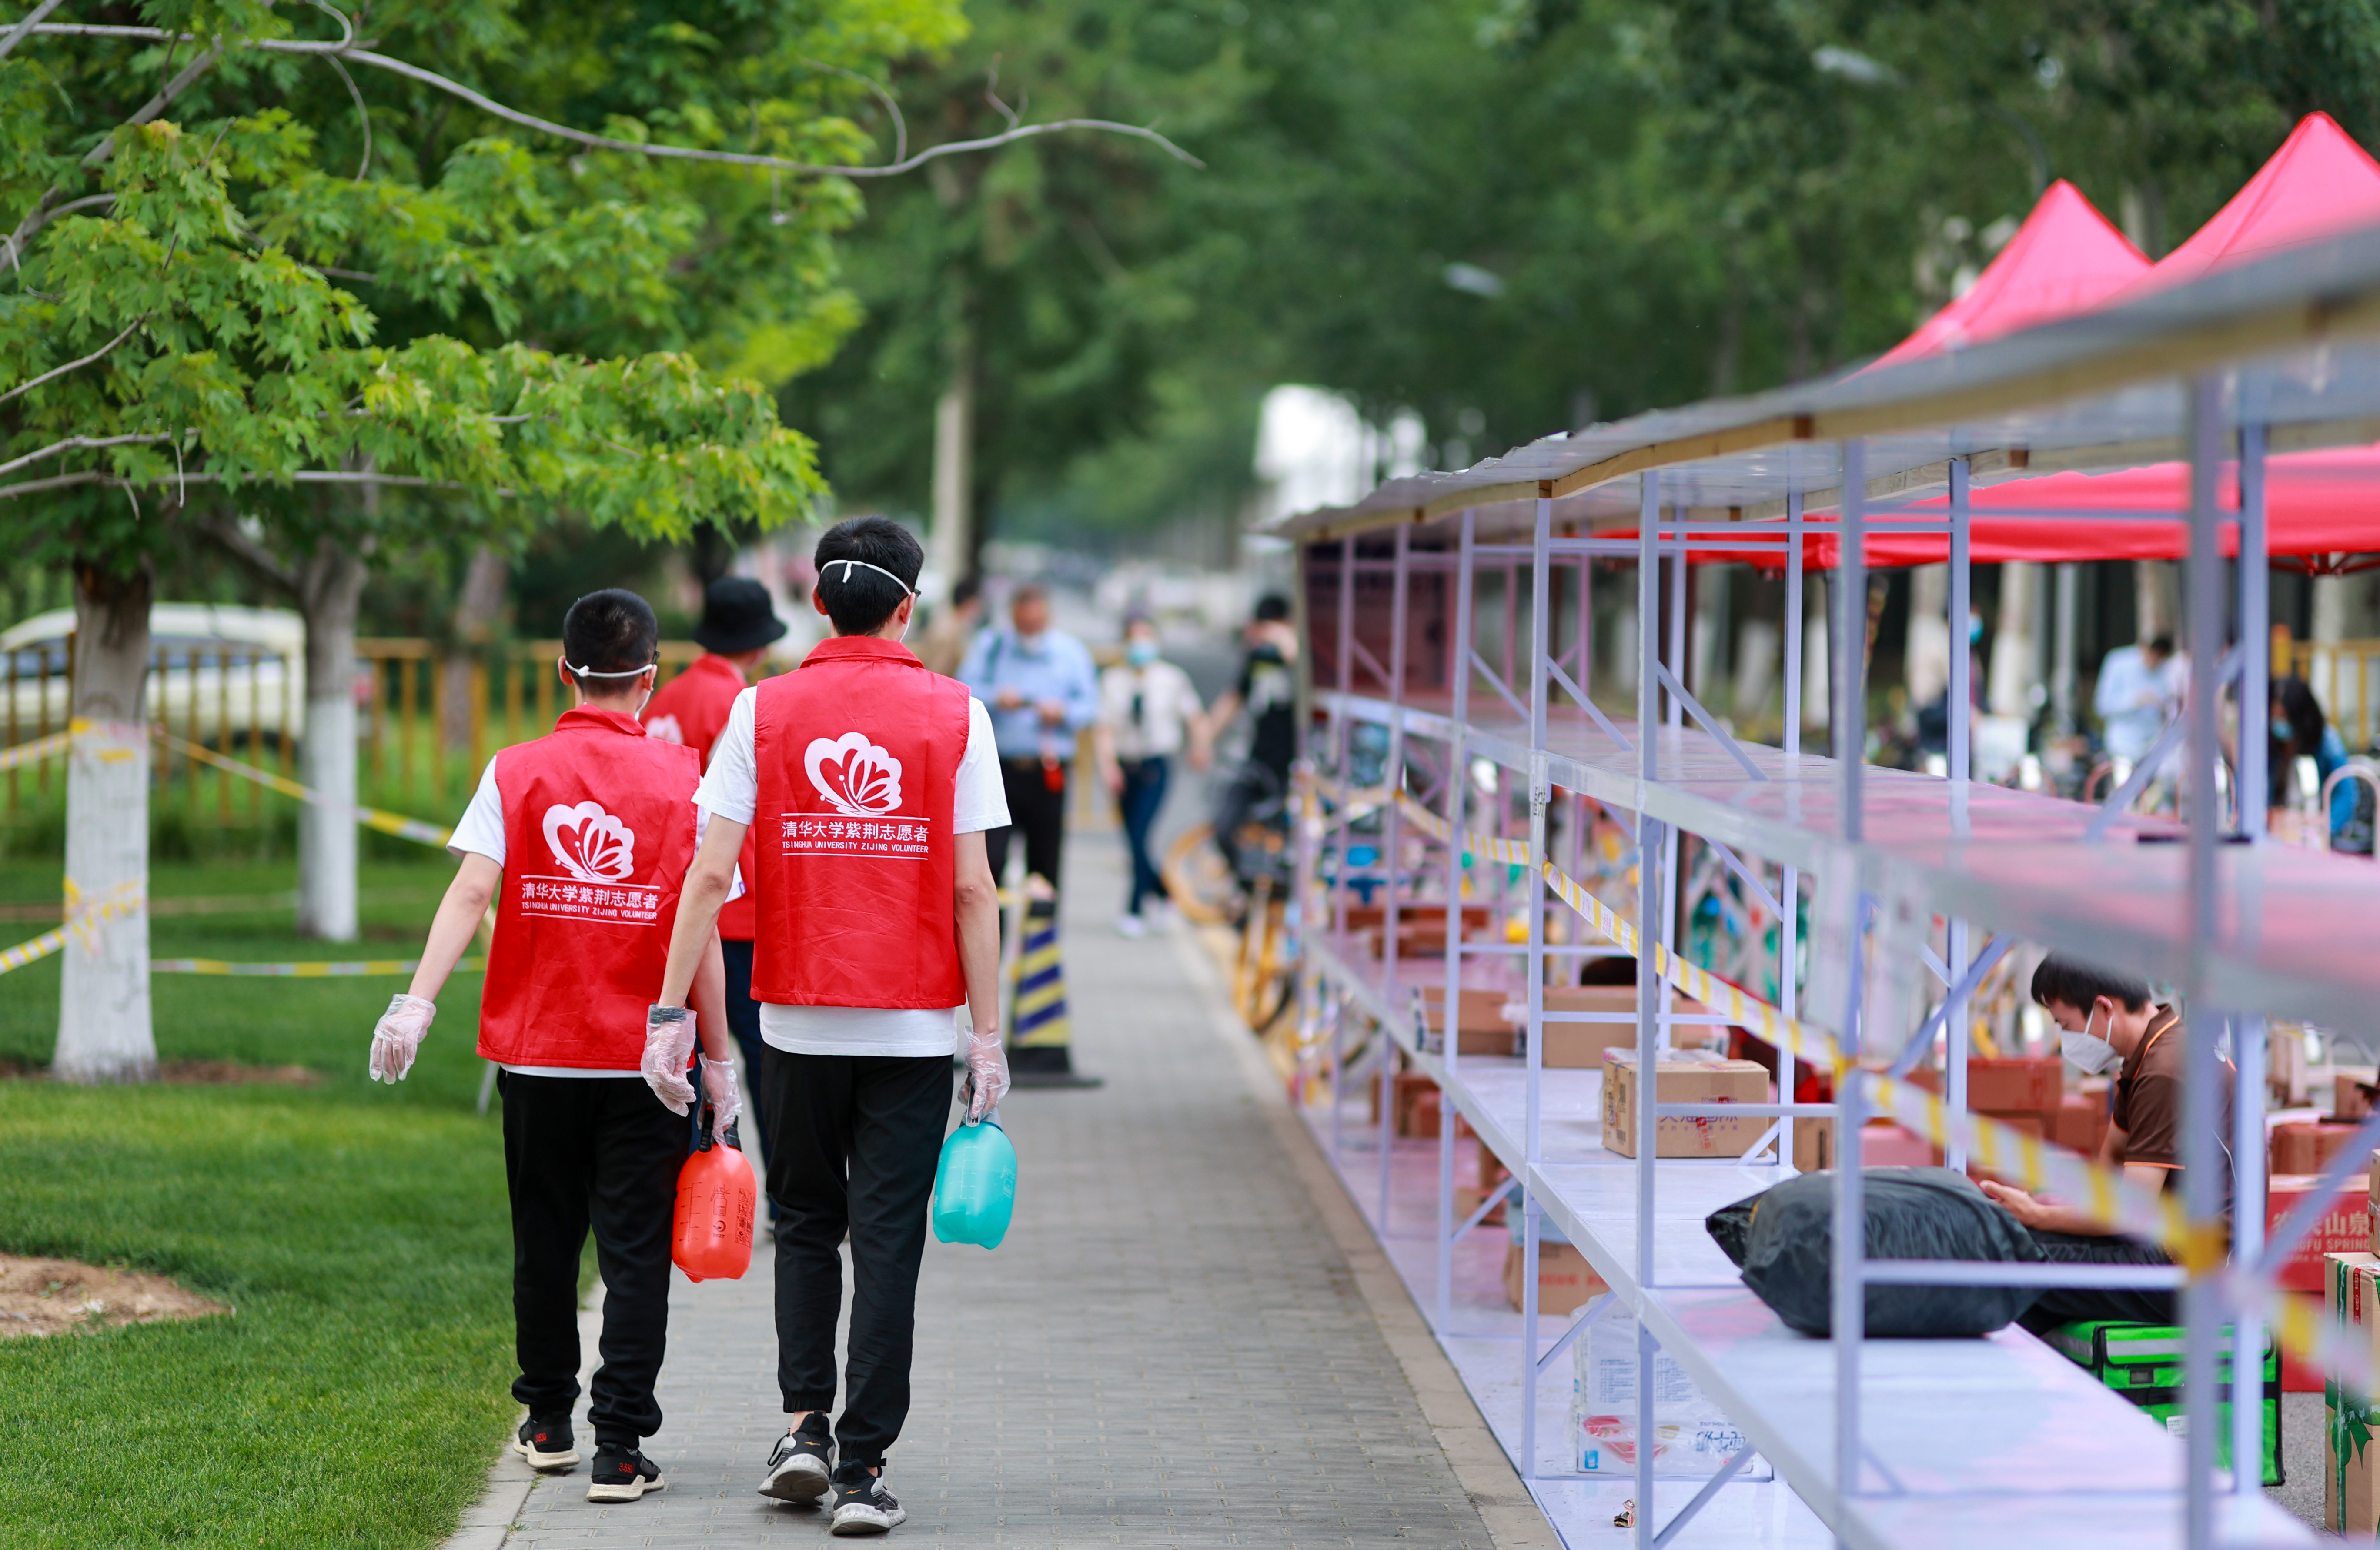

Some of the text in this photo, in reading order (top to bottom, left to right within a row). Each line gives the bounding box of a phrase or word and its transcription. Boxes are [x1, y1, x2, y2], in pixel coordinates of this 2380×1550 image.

[782, 820, 929, 842] 清华大学紫荆志愿者
[815, 842, 857, 850] UNIVERSITY
[861, 842, 888, 851] ZIJING
[891, 844, 929, 853] VOLUNTEER
[522, 882, 659, 909] 清华大学紫荆志愿者
[521, 901, 657, 919] TSINGHUA UNIVERSITY ZIJING VOLUNTEER
[2327, 1238, 2370, 1252] SPRING
